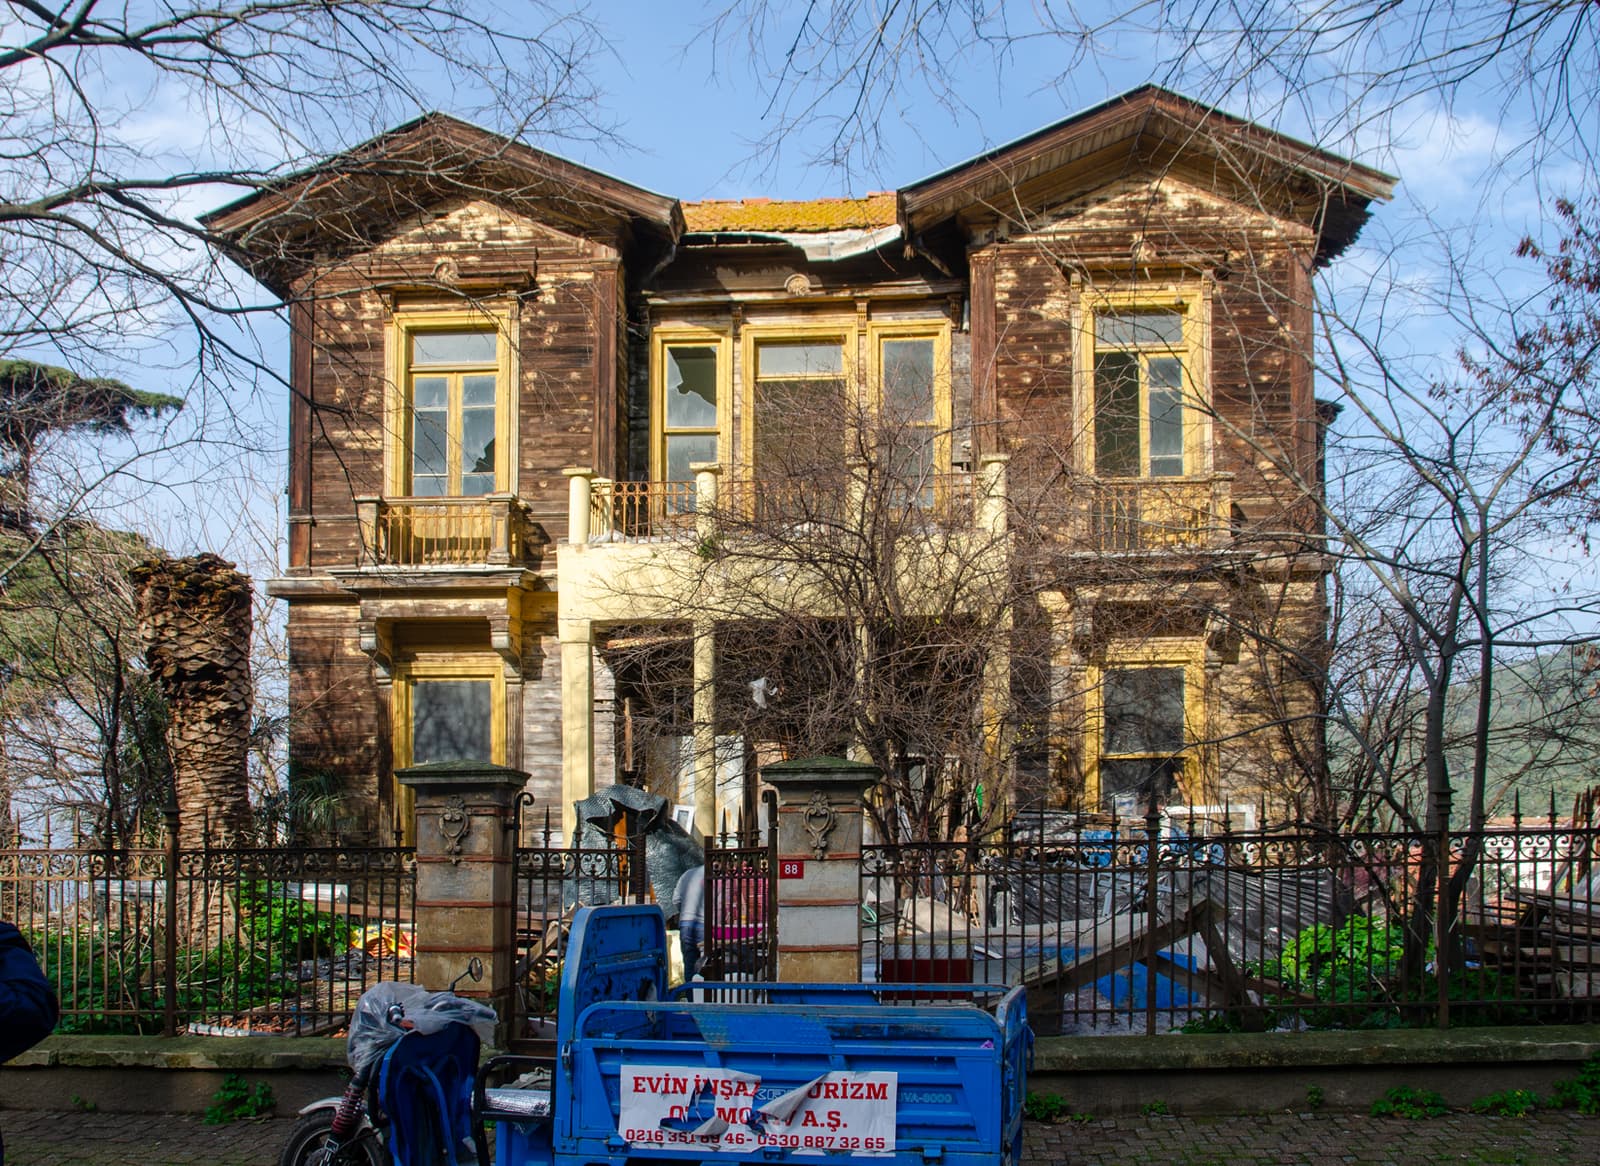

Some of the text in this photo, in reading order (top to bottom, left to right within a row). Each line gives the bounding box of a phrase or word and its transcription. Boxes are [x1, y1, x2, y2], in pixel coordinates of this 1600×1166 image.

[785, 864, 798, 874] 88
[632, 1073, 688, 1095] EVİN
[807, 1078, 889, 1100] URİZM
[626, 1129, 664, 1142] 0216
[668, 1131, 697, 1144] 351
[757, 1134, 800, 1148] 0530
[804, 1135, 835, 1148] 887
[839, 1137, 860, 1149] 32
[864, 1137, 885, 1149] 65
